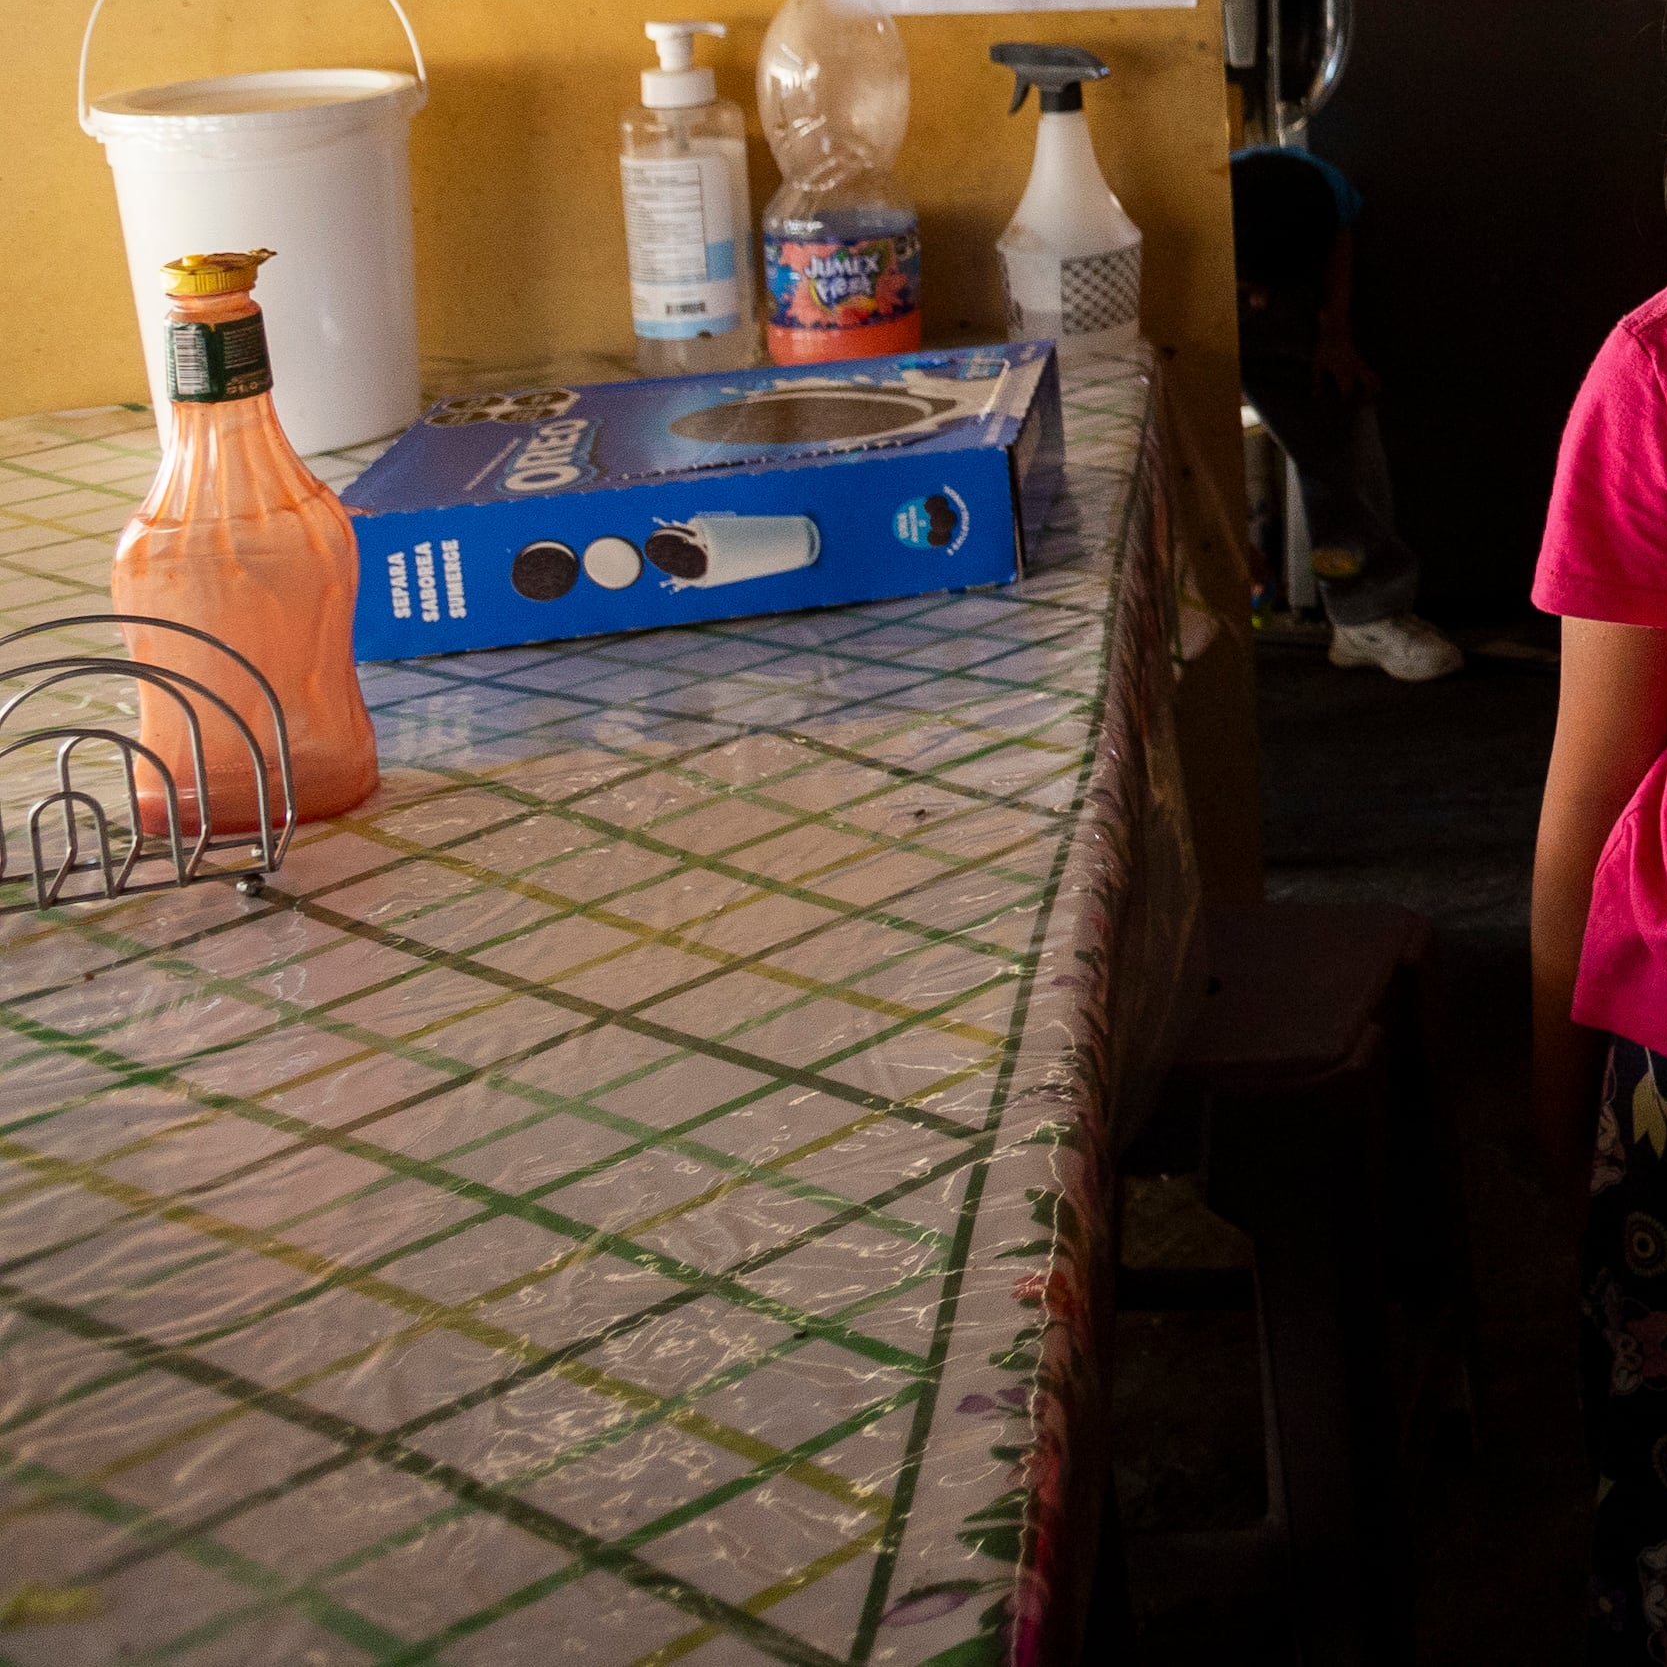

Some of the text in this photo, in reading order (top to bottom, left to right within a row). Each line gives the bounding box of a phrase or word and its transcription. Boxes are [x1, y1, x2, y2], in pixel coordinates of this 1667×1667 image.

[503, 418, 590, 492] OREO
[386, 550, 412, 619] SEPARA
[413, 540, 440, 622] SABOREA
[440, 538, 468, 619] SUMERGE
